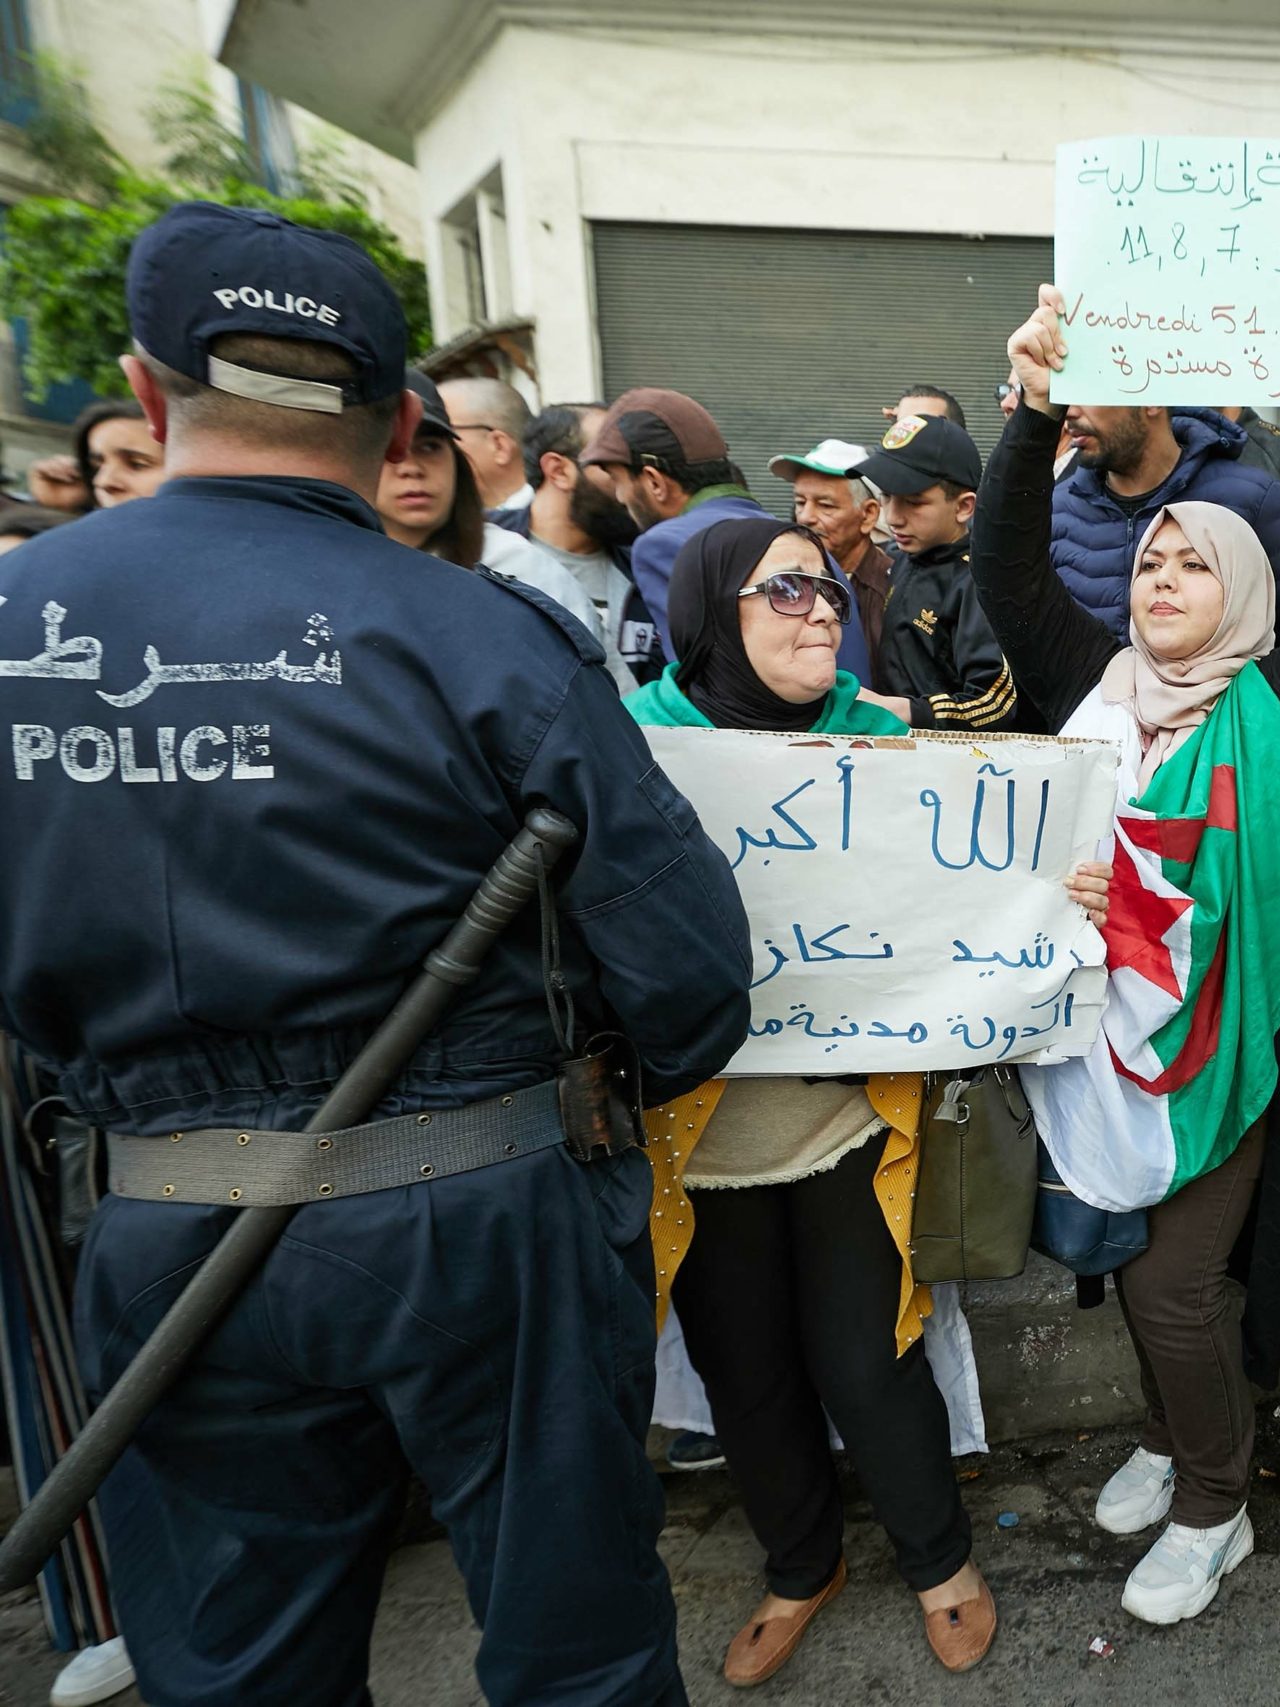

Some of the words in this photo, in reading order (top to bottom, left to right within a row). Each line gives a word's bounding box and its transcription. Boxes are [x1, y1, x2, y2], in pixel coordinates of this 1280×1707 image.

[212, 286, 342, 327] POLICE
[1063, 292, 1203, 333] Vendredi
[0, 594, 342, 708] شرط
[912, 618, 934, 636] adidas
[12, 723, 275, 783] POLICE
[731, 755, 854, 871] أكبر
[786, 1003, 929, 1053] مدنية
